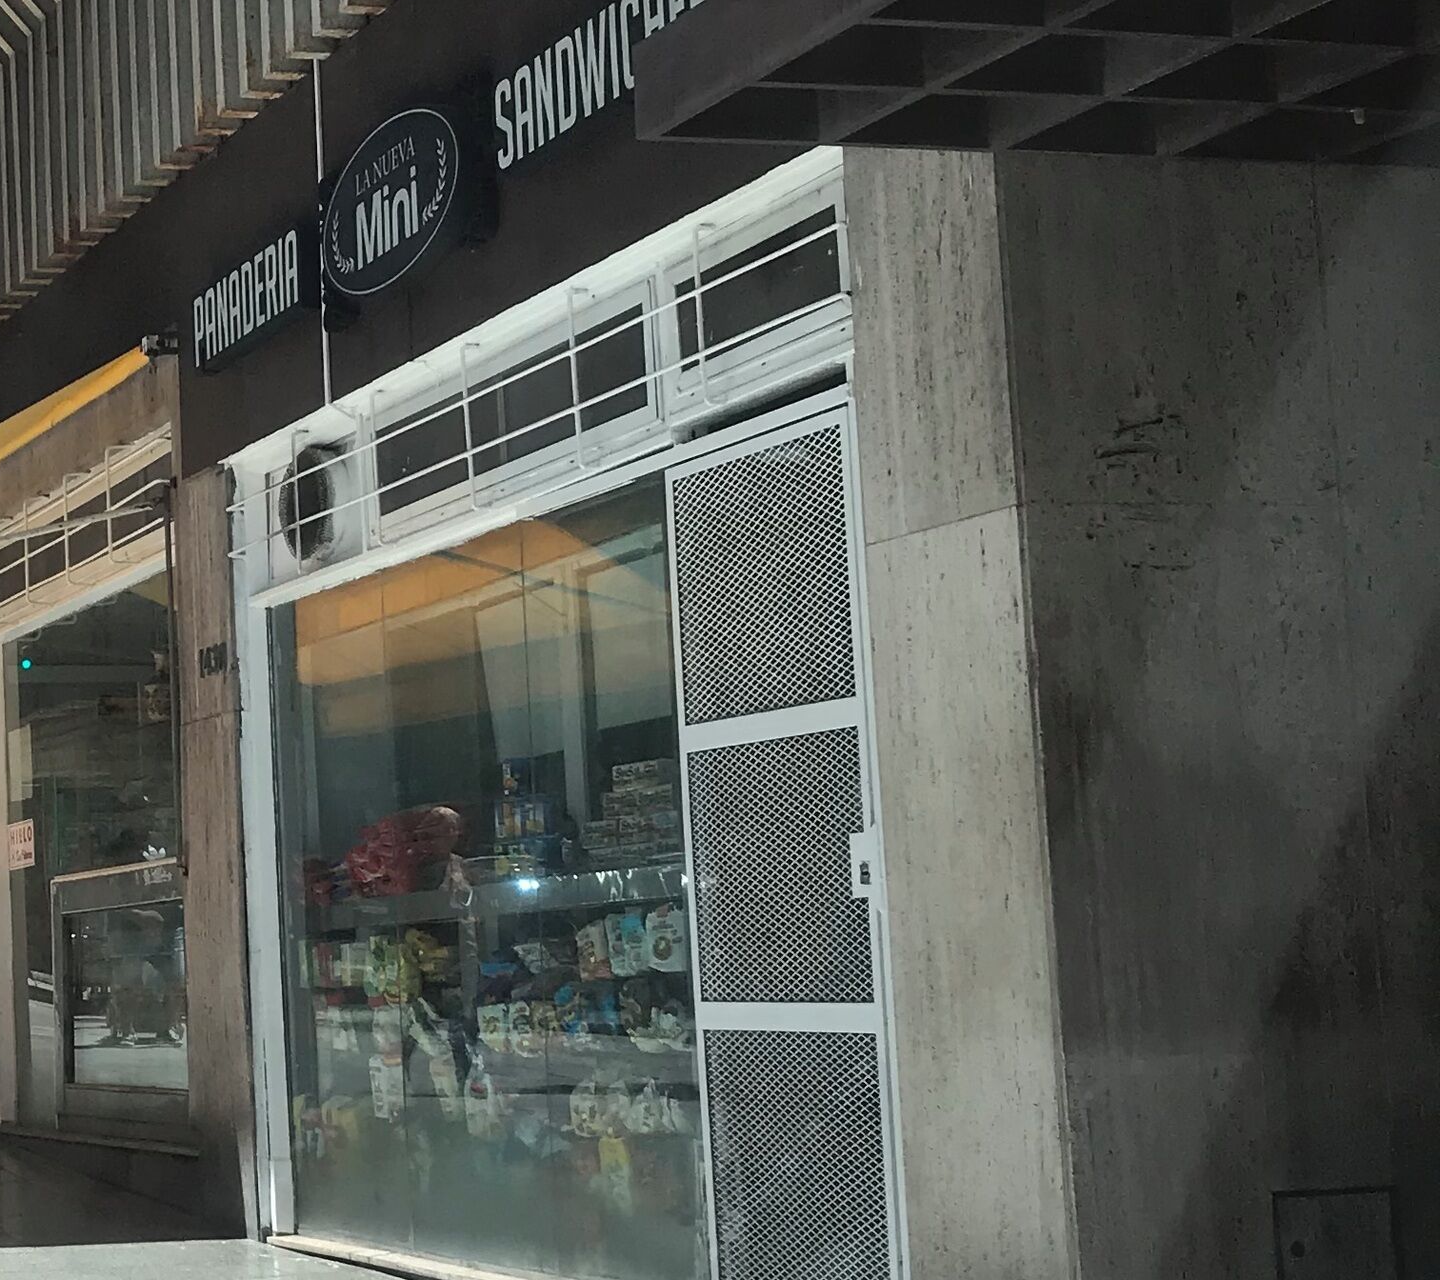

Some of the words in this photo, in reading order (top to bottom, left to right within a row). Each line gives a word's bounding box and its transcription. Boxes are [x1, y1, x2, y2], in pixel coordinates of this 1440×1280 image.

[355, 168, 371, 197] LA
[372, 135, 416, 183] NUEVA
[355, 165, 419, 271] Mini
[193, 229, 299, 368] PANADERIA
